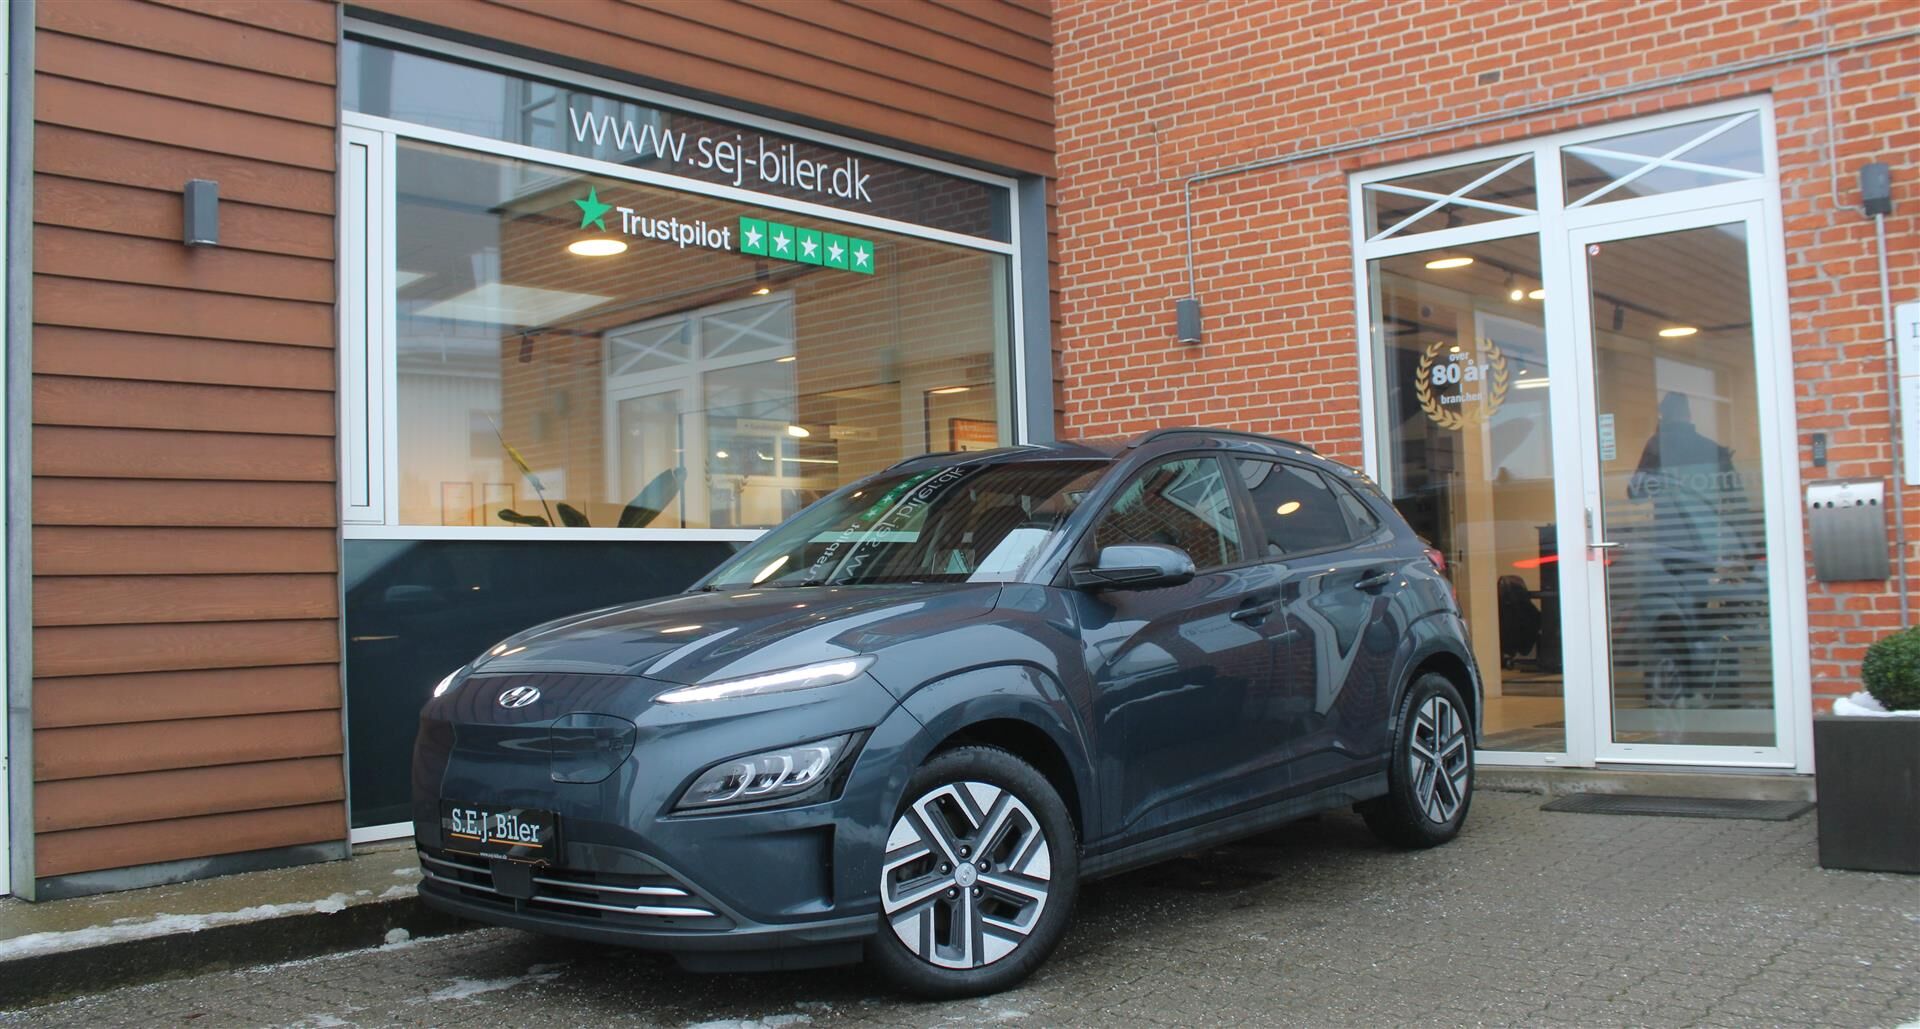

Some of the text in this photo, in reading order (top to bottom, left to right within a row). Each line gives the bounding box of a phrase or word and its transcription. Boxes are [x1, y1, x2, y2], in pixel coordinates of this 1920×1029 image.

[569, 107, 872, 203] www.sej-biler.dk
[616, 206, 731, 251] Trustpilot
[1449, 352, 1470, 361] over
[1431, 359, 1489, 386] 80 år
[1440, 393, 1483, 405] branchen
[451, 807, 540, 843] S.E.J. Biler
